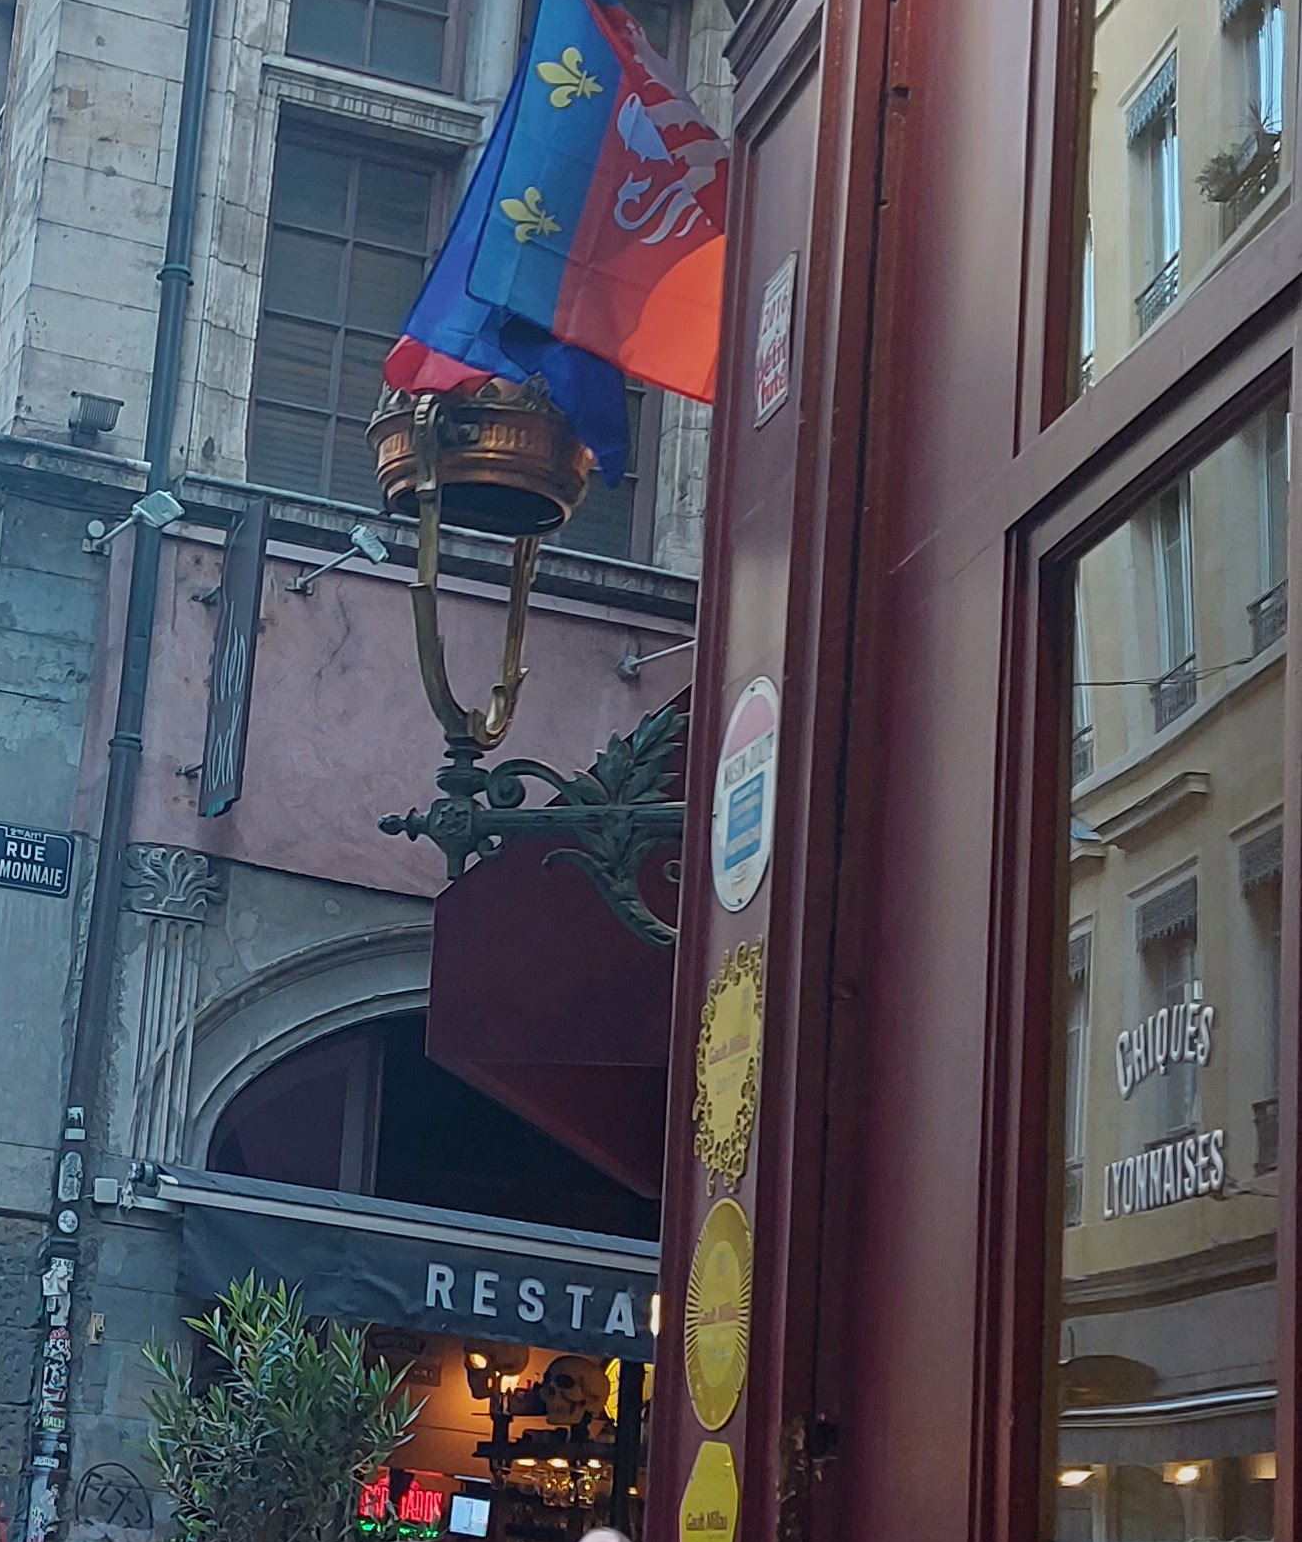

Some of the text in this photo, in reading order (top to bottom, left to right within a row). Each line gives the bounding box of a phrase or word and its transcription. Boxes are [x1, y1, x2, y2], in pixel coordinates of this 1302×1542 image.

[5, 841, 46, 862] RUE
[1103, 1128, 1225, 1220] LYONNAISES
[425, 1262, 637, 1338] RESTA
